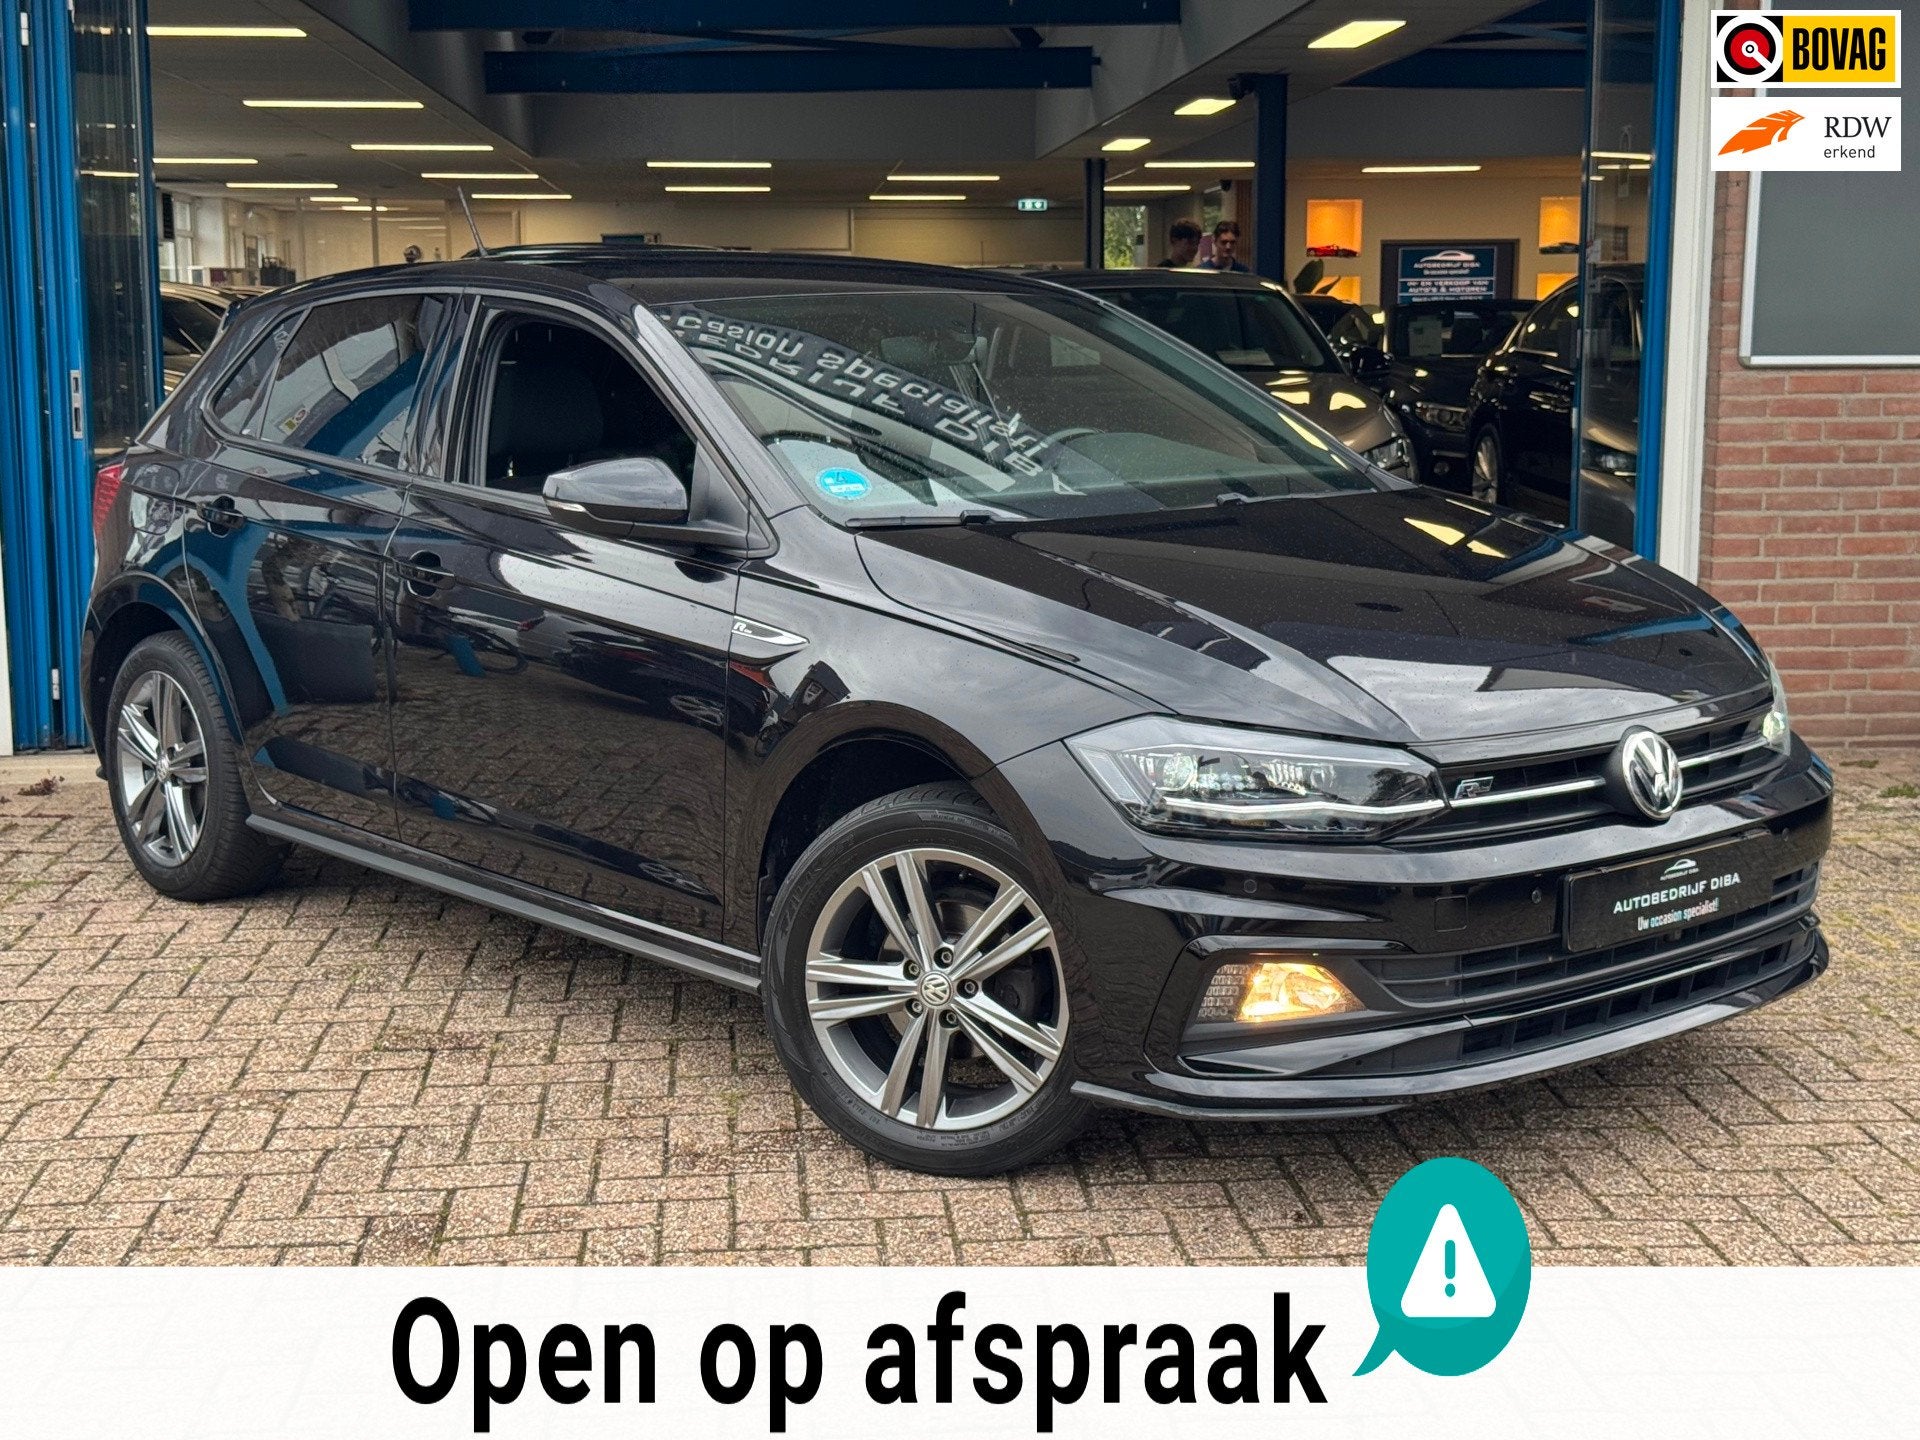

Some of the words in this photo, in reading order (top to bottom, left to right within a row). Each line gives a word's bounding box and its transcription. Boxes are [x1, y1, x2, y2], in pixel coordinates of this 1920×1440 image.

[1613, 880, 1708, 914] AUTOBEDRIJF
[1710, 872, 1741, 890] DIBA
[1638, 916, 1650, 931] Uw
[1650, 909, 1683, 928] occasion
[1683, 897, 1720, 921] specialist!
